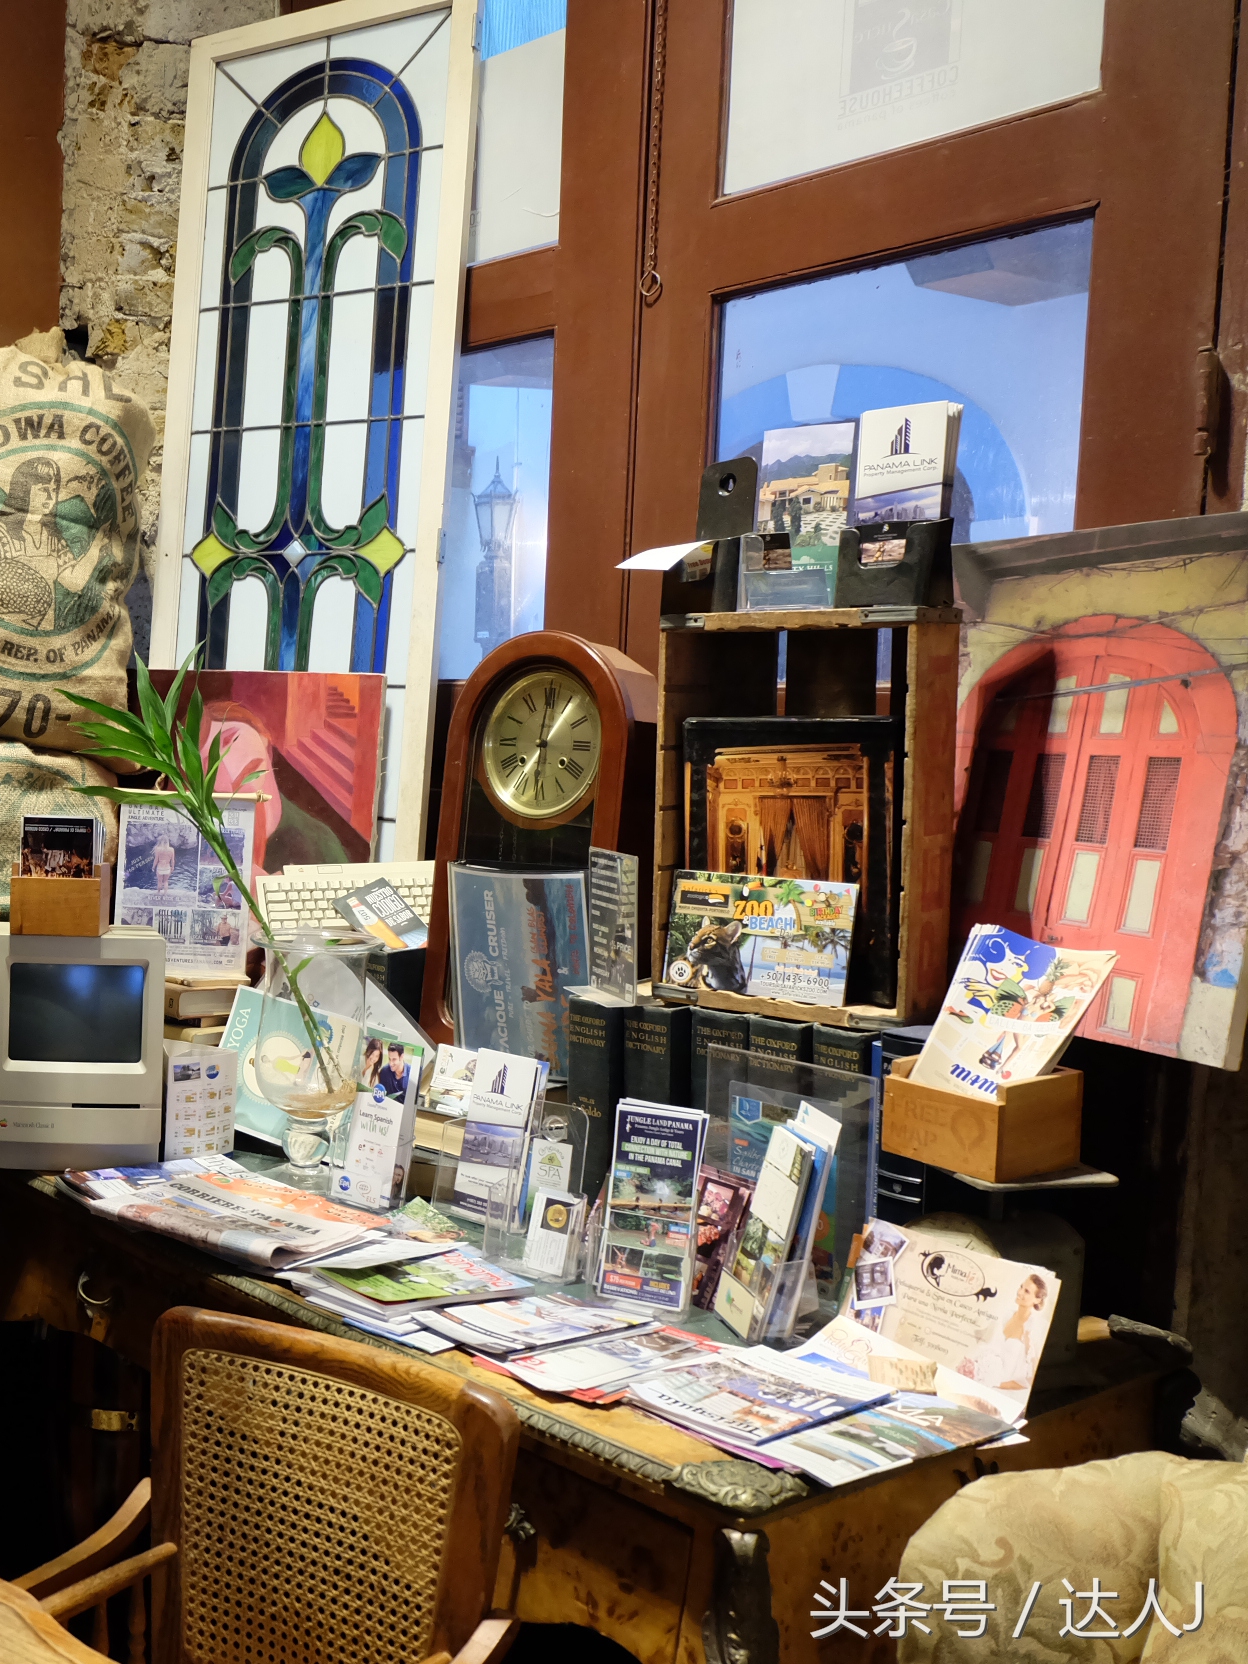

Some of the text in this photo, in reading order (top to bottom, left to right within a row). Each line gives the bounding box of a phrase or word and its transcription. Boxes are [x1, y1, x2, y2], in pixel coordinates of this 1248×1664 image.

[863, 457, 938, 472] PANAMA LINK
[78, 421, 137, 525] COFFEE
[863, 470, 885, 478] Property
[886, 467, 921, 476] Management
[0, 639, 39, 664] REP.
[45, 643, 68, 664] OF
[364, 886, 394, 905] NUESTRO
[358, 909, 371, 921] 507
[392, 909, 414, 923] SABOR
[733, 900, 774, 920] ZOO
[809, 906, 843, 917] BIRTHDAY
[483, 889, 499, 957] CRUISER
[742, 916, 794, 931] & BEACH
[499, 927, 509, 961] FREEDOM
[616, 941, 632, 955] PRICE
[503, 968, 512, 993] TRAVEL
[531, 958, 556, 1003] YALA
[786, 974, 830, 988] 435-6900
[227, 1007, 252, 1048] YOGA
[570, 1013, 606, 1027] THE OXFORD
[626, 1020, 667, 1033] THE OXFORD
[569, 1024, 606, 1037] ENGLISH
[626, 1031, 667, 1044] ENGLISH
[696, 1025, 744, 1040] THE OXFORD
[569, 1034, 606, 1048] DICTIONARY
[626, 1042, 667, 1055] DICTIONARY
[696, 1037, 743, 1050] ENGLISH
[751, 1035, 798, 1051] THE OXFORD
[696, 1047, 742, 1062] DICTIONARY
[750, 1046, 797, 1061] ENGLISH
[815, 1043, 860, 1061] THE OXFORD
[749, 1057, 796, 1073] DICTIONARY
[814, 1054, 859, 1072] ENGLISH
[473, 1093, 524, 1111] PANAMA LINK
[486, 1103, 511, 1113] Management
[359, 1109, 394, 1125] Learn Spanish
[889, 1096, 948, 1126] FREE
[360, 1121, 377, 1134] with
[626, 1115, 693, 1131] JUNGLE LAND PANAMA
[631, 1135, 646, 1145] ENJOY
[651, 1138, 660, 1147] DAY
[661, 1139, 668, 1147] OF
[668, 1140, 683, 1150] TOTAL
[625, 1143, 689, 1160] CONNECTION WITH NATURE
[628, 1152, 682, 1168] IN THE PANAMA CANAL
[537, 1165, 562, 1180] SPA
[733, 1165, 757, 1178] IN SAN
[169, 1182, 246, 1214] CORRIERE
